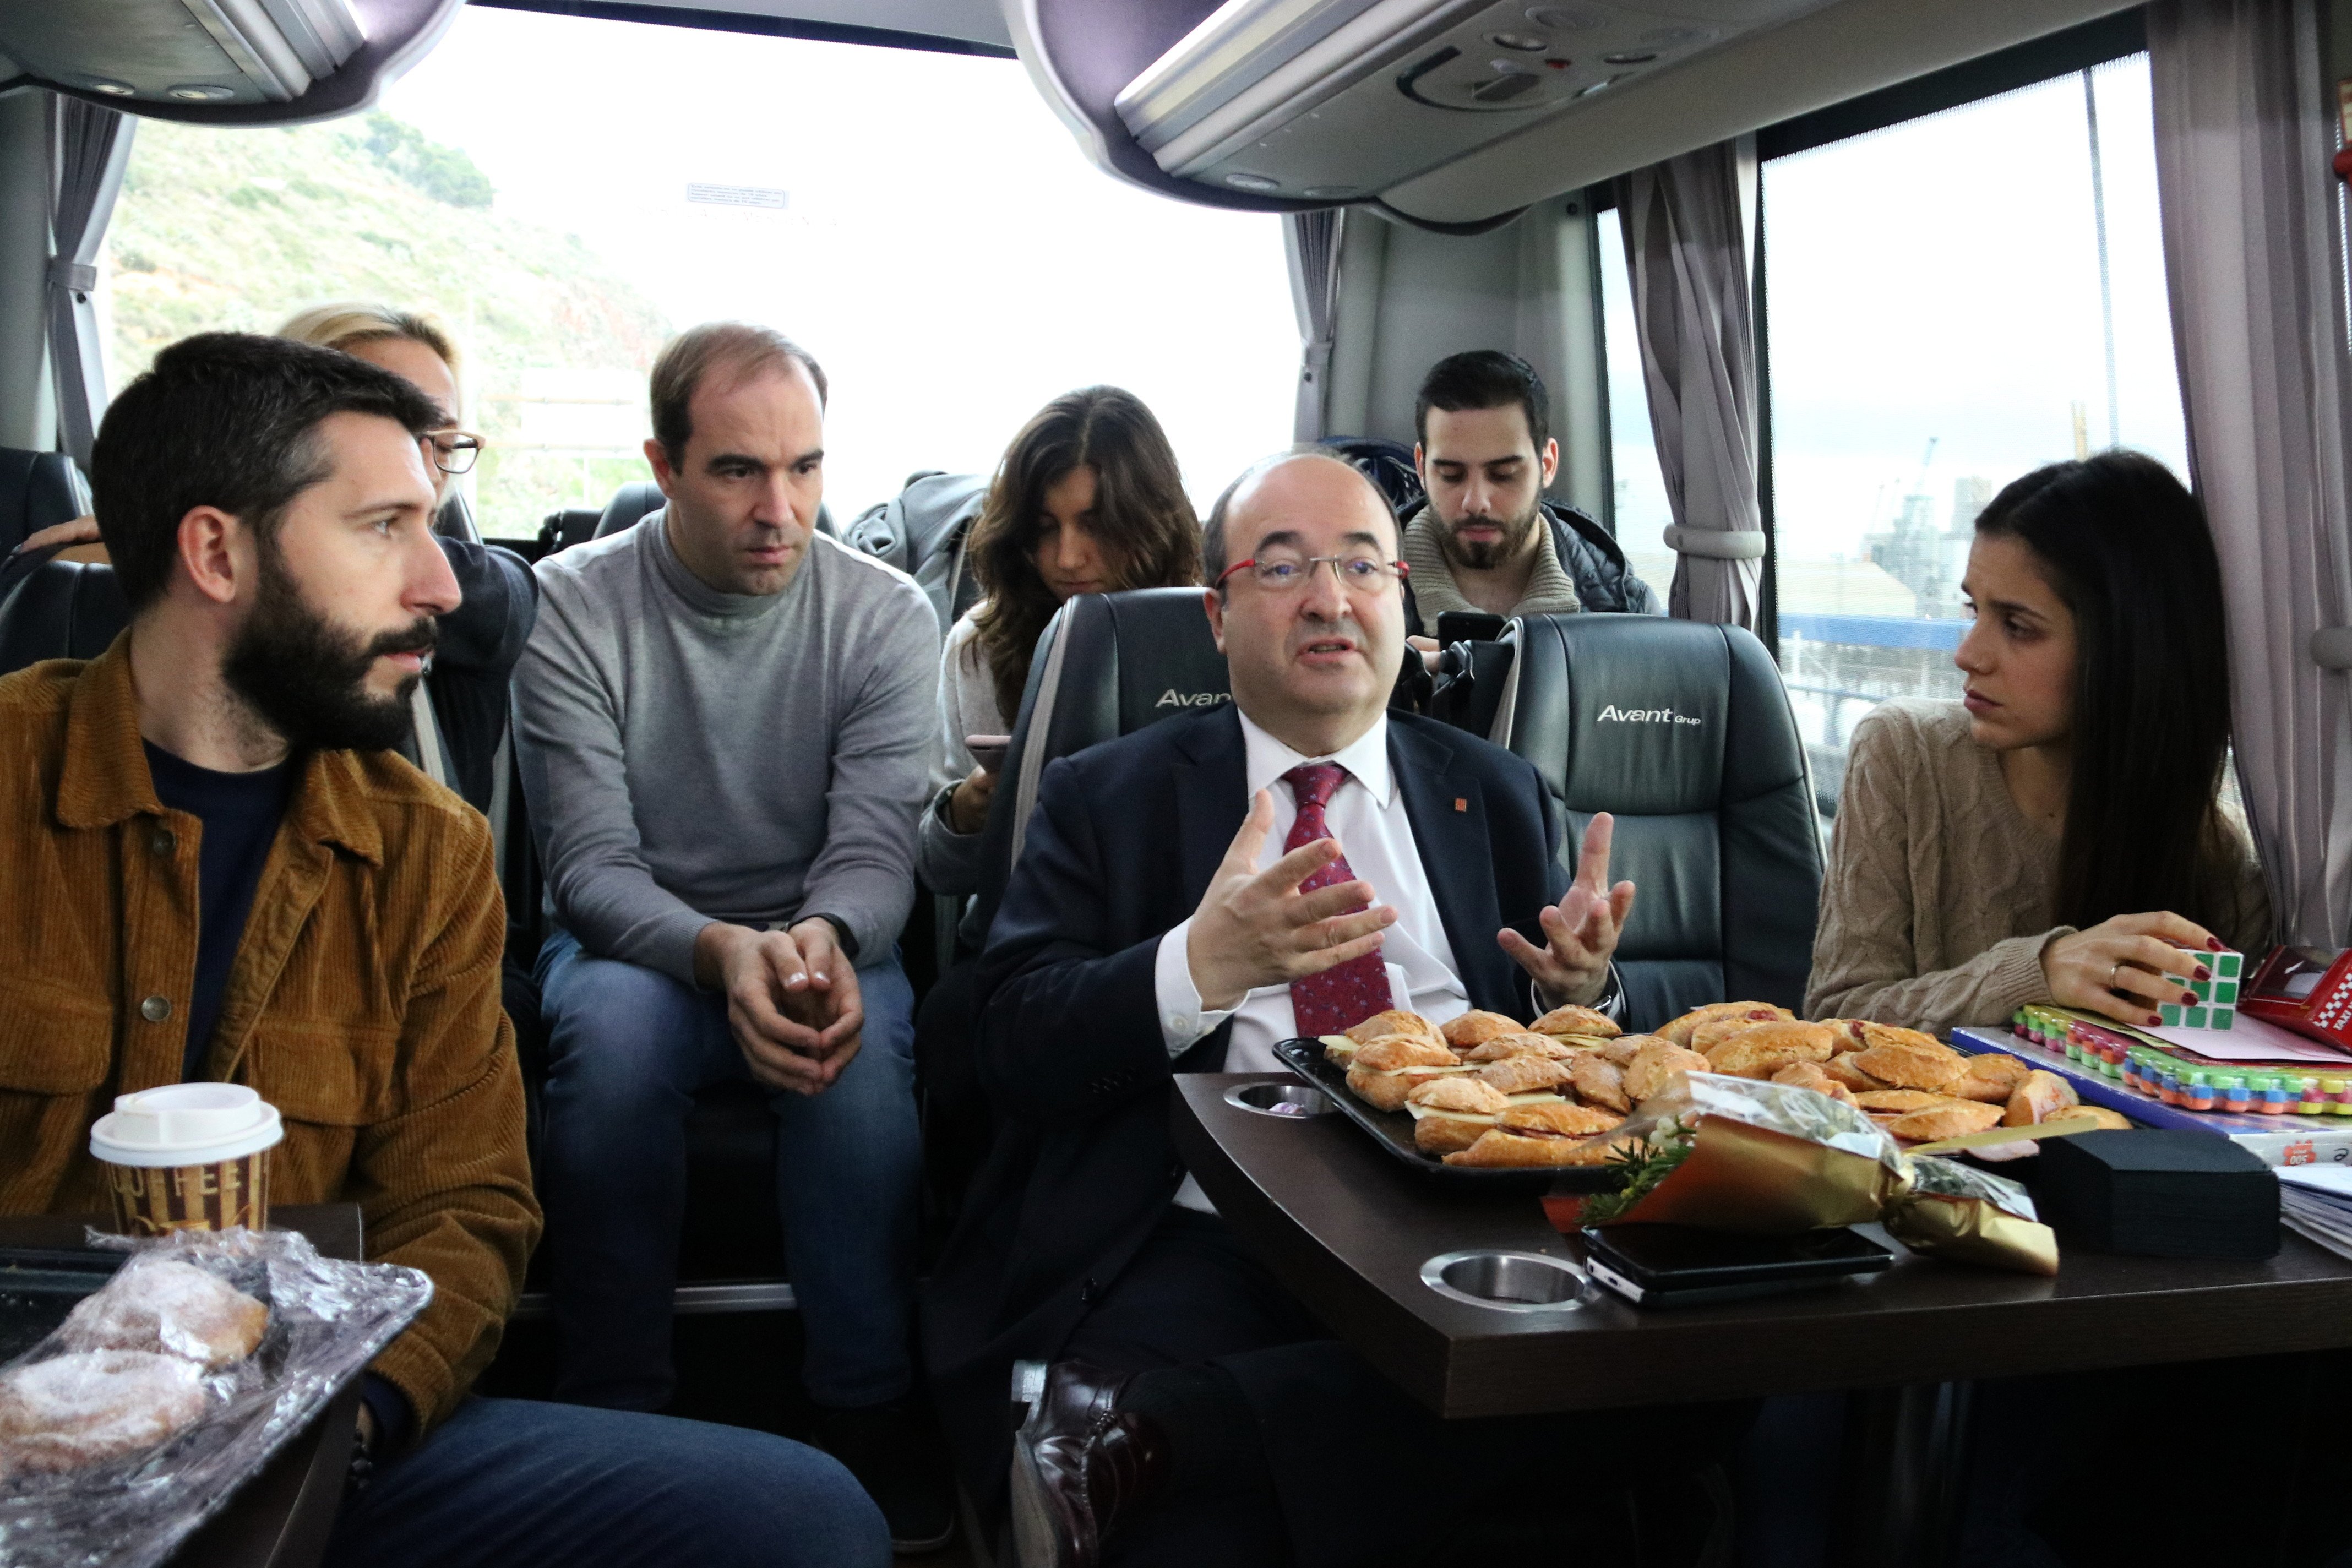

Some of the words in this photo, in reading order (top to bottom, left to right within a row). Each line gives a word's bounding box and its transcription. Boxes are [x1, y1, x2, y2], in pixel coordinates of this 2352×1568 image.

[1155, 689, 1231, 707] Avan
[1597, 705, 1673, 722] Avant
[1674, 715, 1701, 726] Grup
[2333, 1010, 2352, 1031] TAXI
